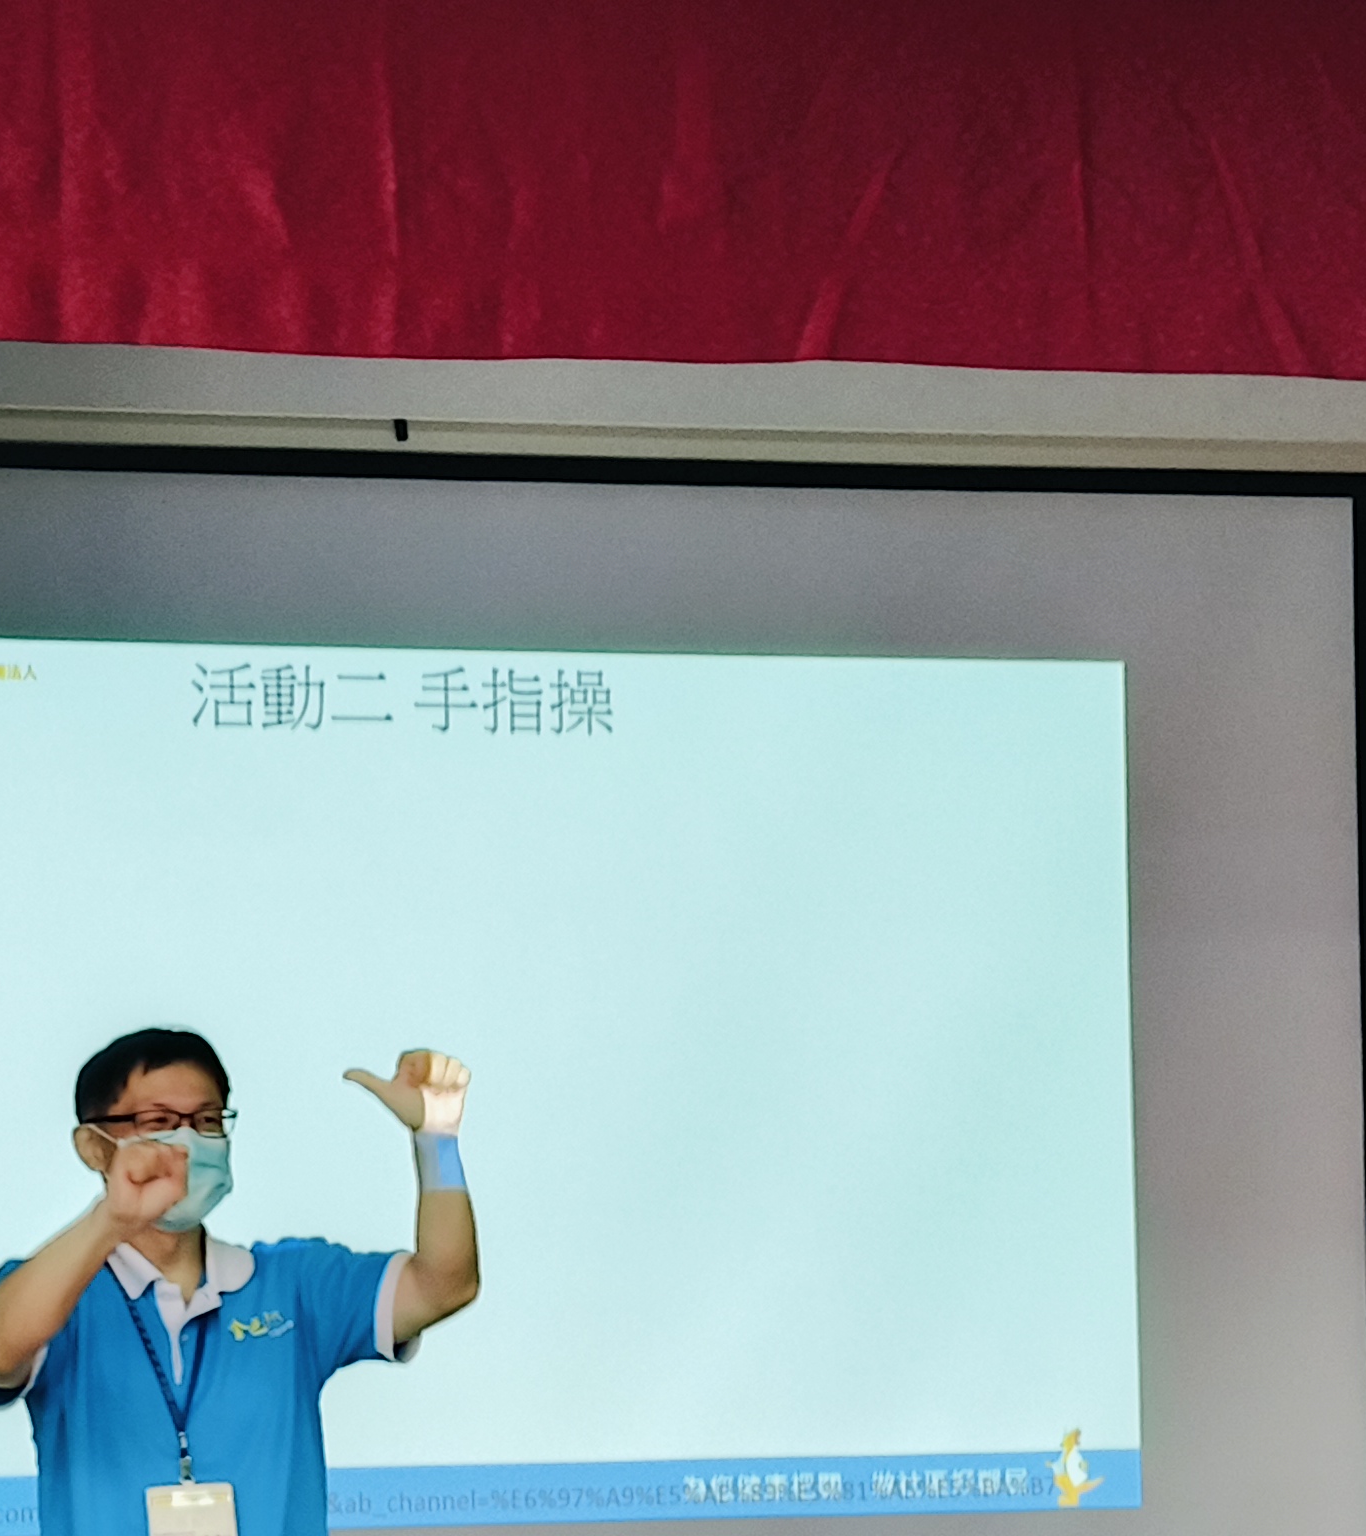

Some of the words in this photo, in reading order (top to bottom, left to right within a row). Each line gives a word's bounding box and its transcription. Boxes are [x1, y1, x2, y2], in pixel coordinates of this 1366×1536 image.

[191, 663, 393, 731] 活動二
[414, 667, 613, 736] 手指操
